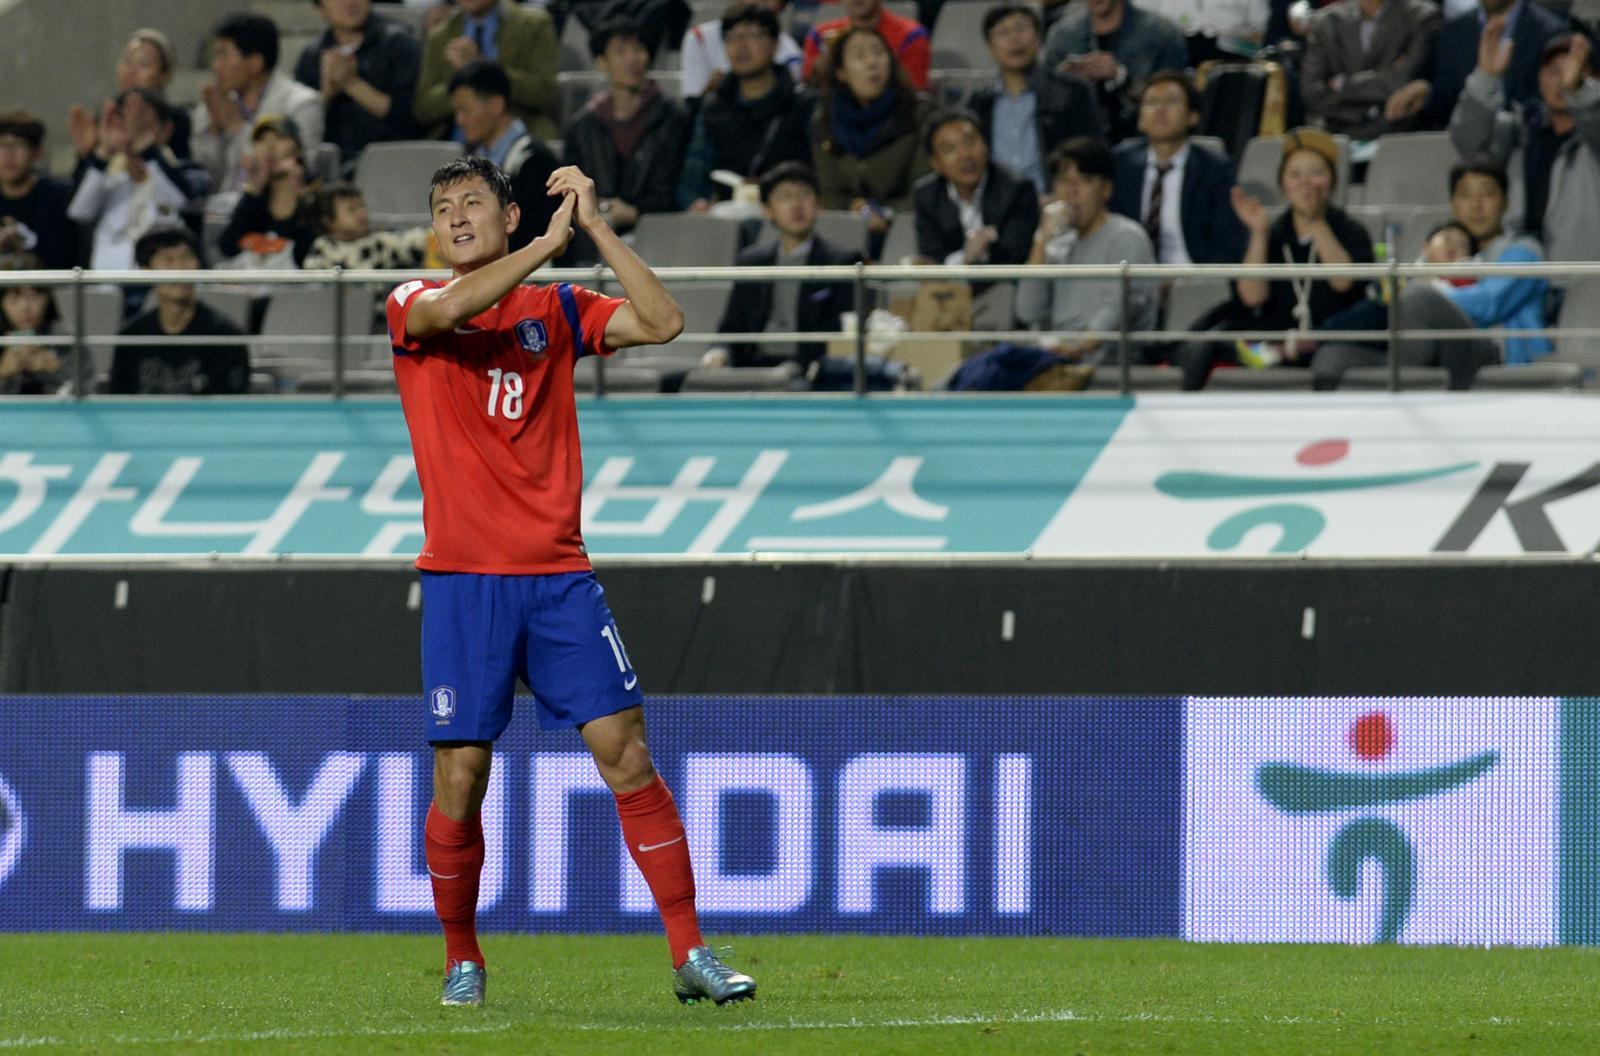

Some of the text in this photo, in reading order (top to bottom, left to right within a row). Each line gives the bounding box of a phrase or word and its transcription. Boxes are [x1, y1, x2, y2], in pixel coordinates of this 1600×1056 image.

[488, 368, 523, 420] 18
[0, 450, 949, 553] 하나버스
[1433, 462, 1600, 552] K
[85, 750, 1032, 912] HYUNDAI
